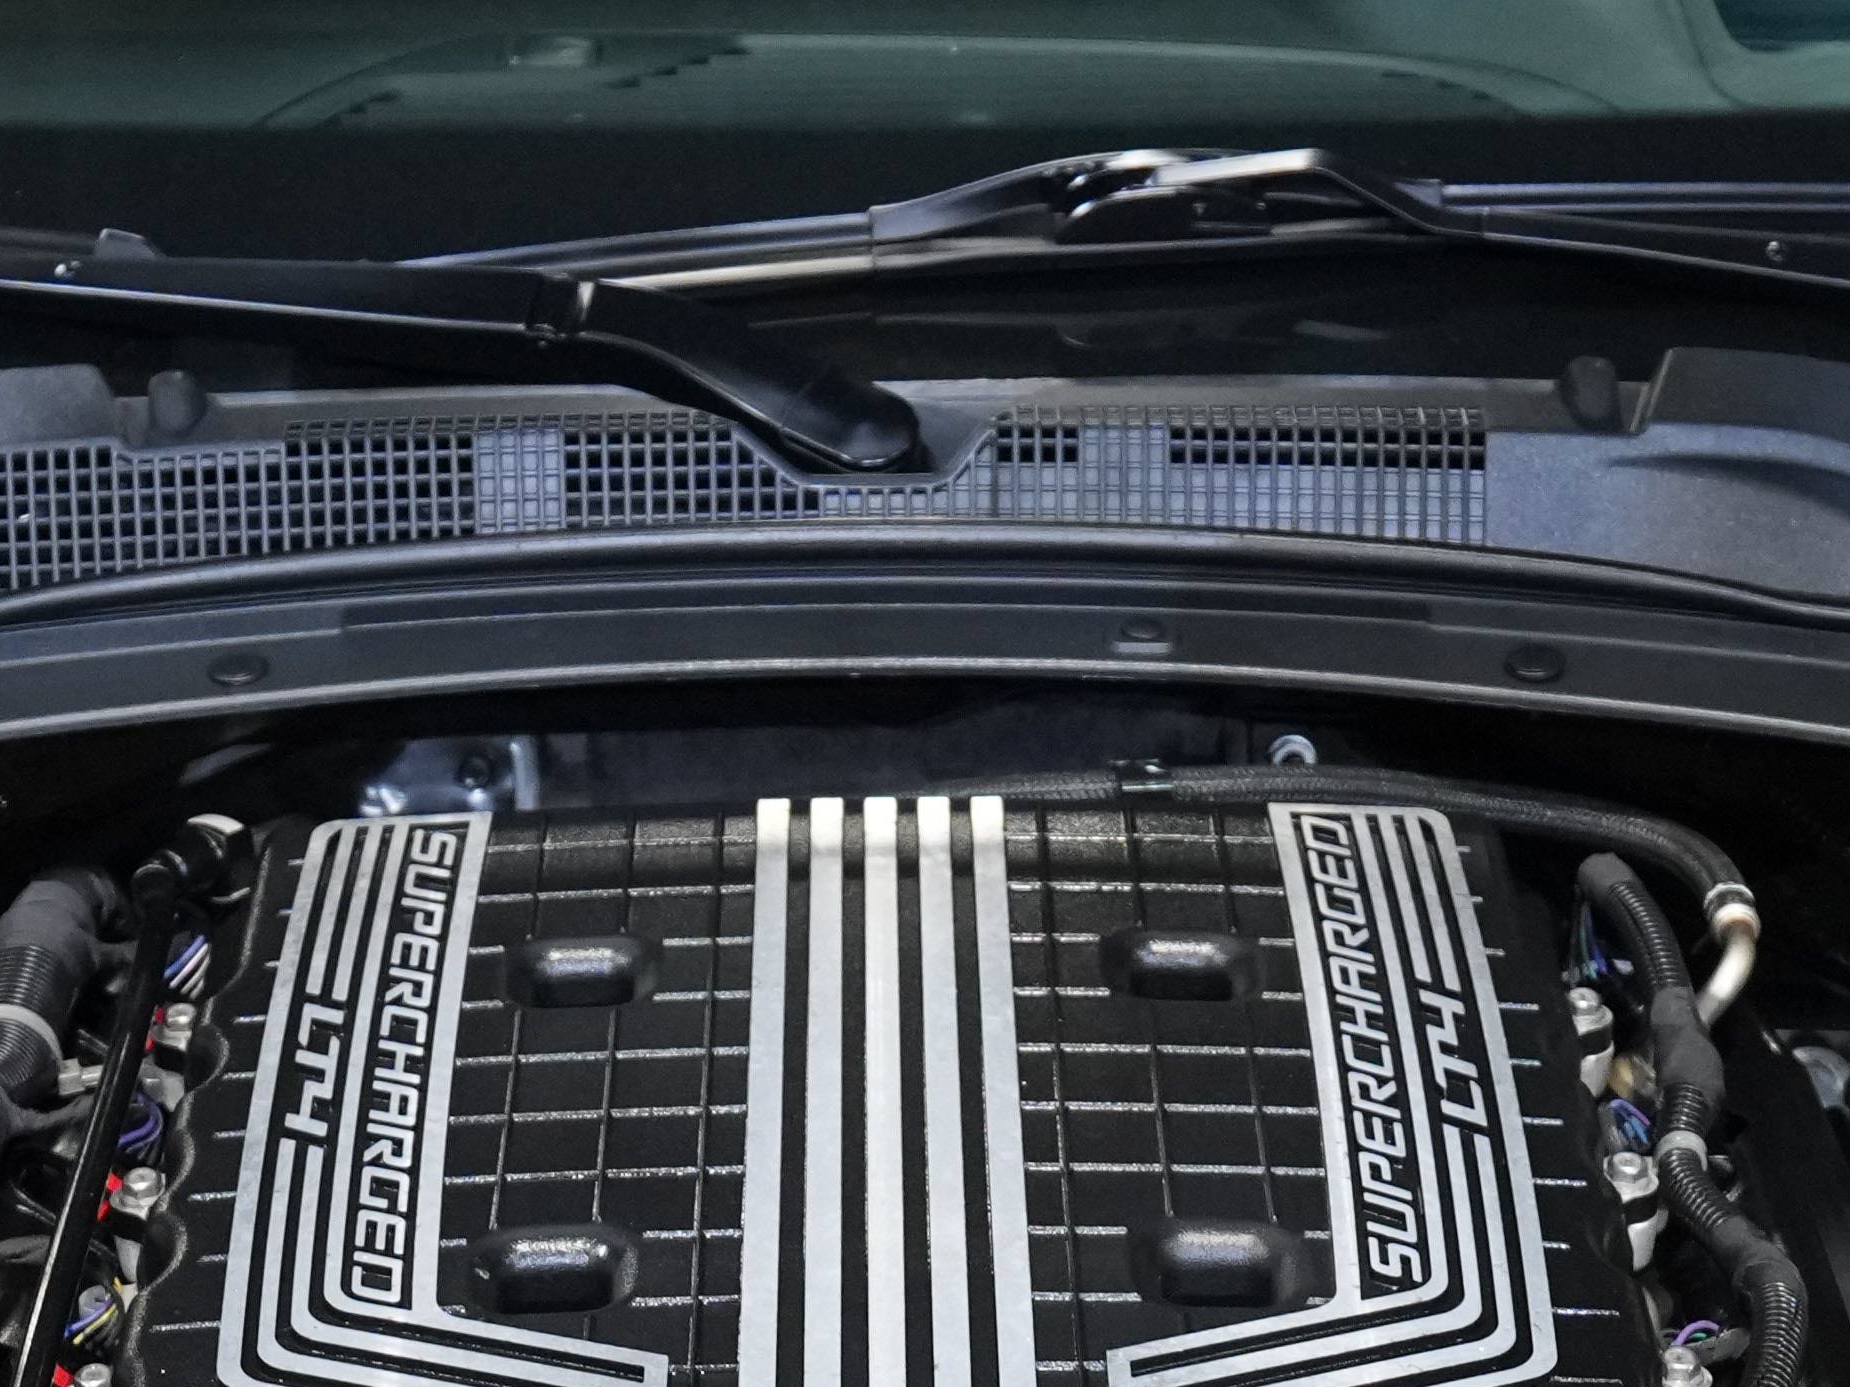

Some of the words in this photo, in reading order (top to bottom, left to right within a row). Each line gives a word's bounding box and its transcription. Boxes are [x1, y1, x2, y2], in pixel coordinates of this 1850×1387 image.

[285, 1009, 344, 1136] LT4
[350, 828, 457, 1304] SUPERCHARGED
[1302, 815, 1422, 1284] SUPERCHARGED
[1424, 993, 1487, 1128] LT4
